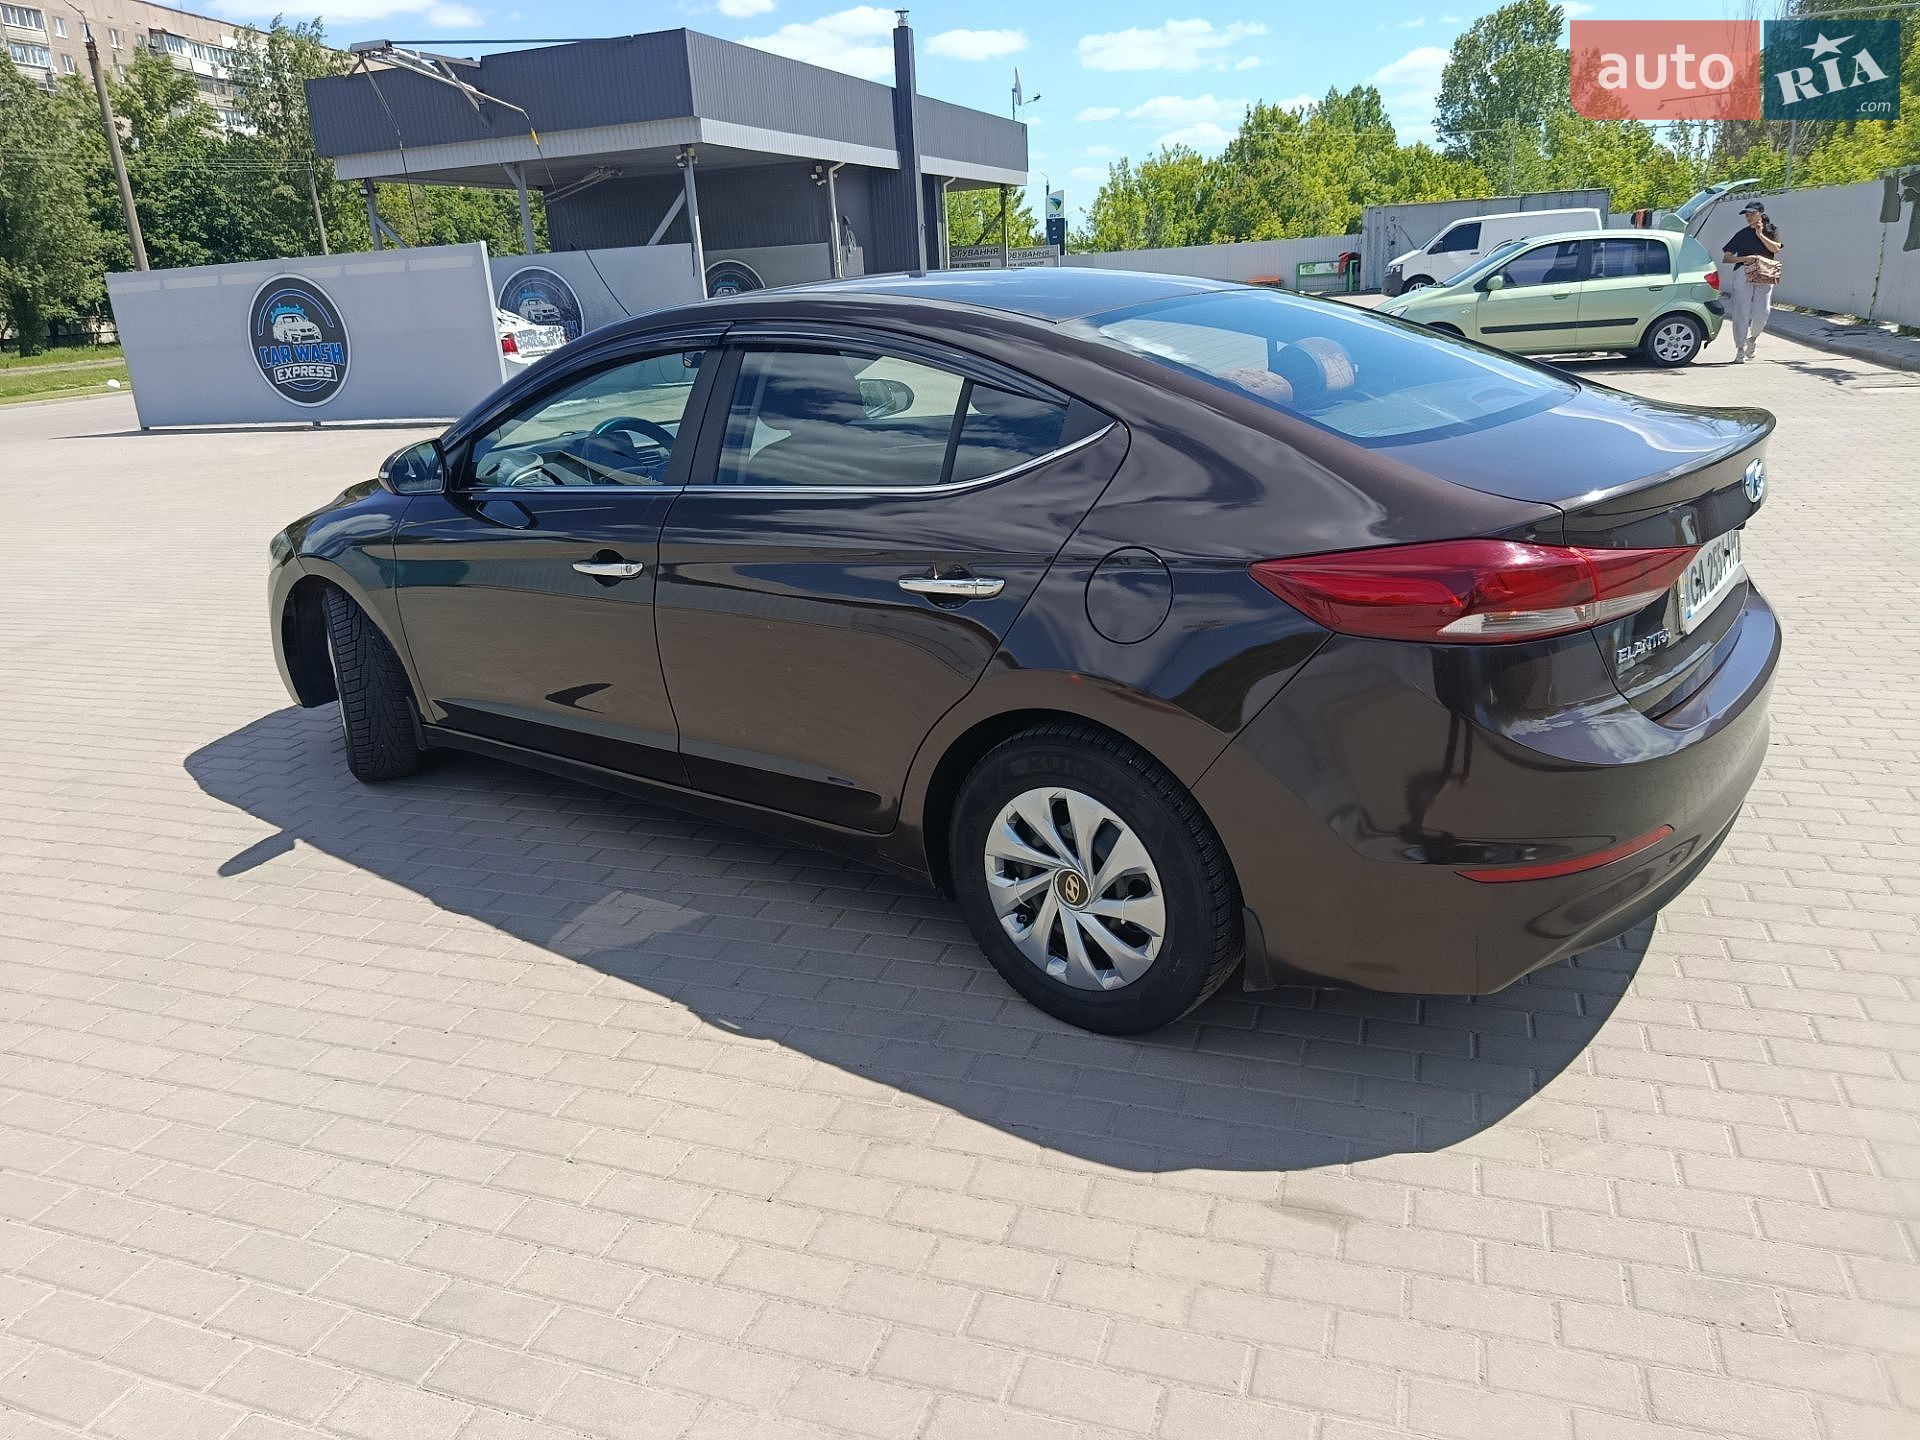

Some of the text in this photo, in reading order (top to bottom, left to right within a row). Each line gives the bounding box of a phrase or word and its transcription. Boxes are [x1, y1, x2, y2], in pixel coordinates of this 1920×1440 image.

[259, 342, 345, 369] CAR WASH
[277, 366, 332, 380] EXPRESS
